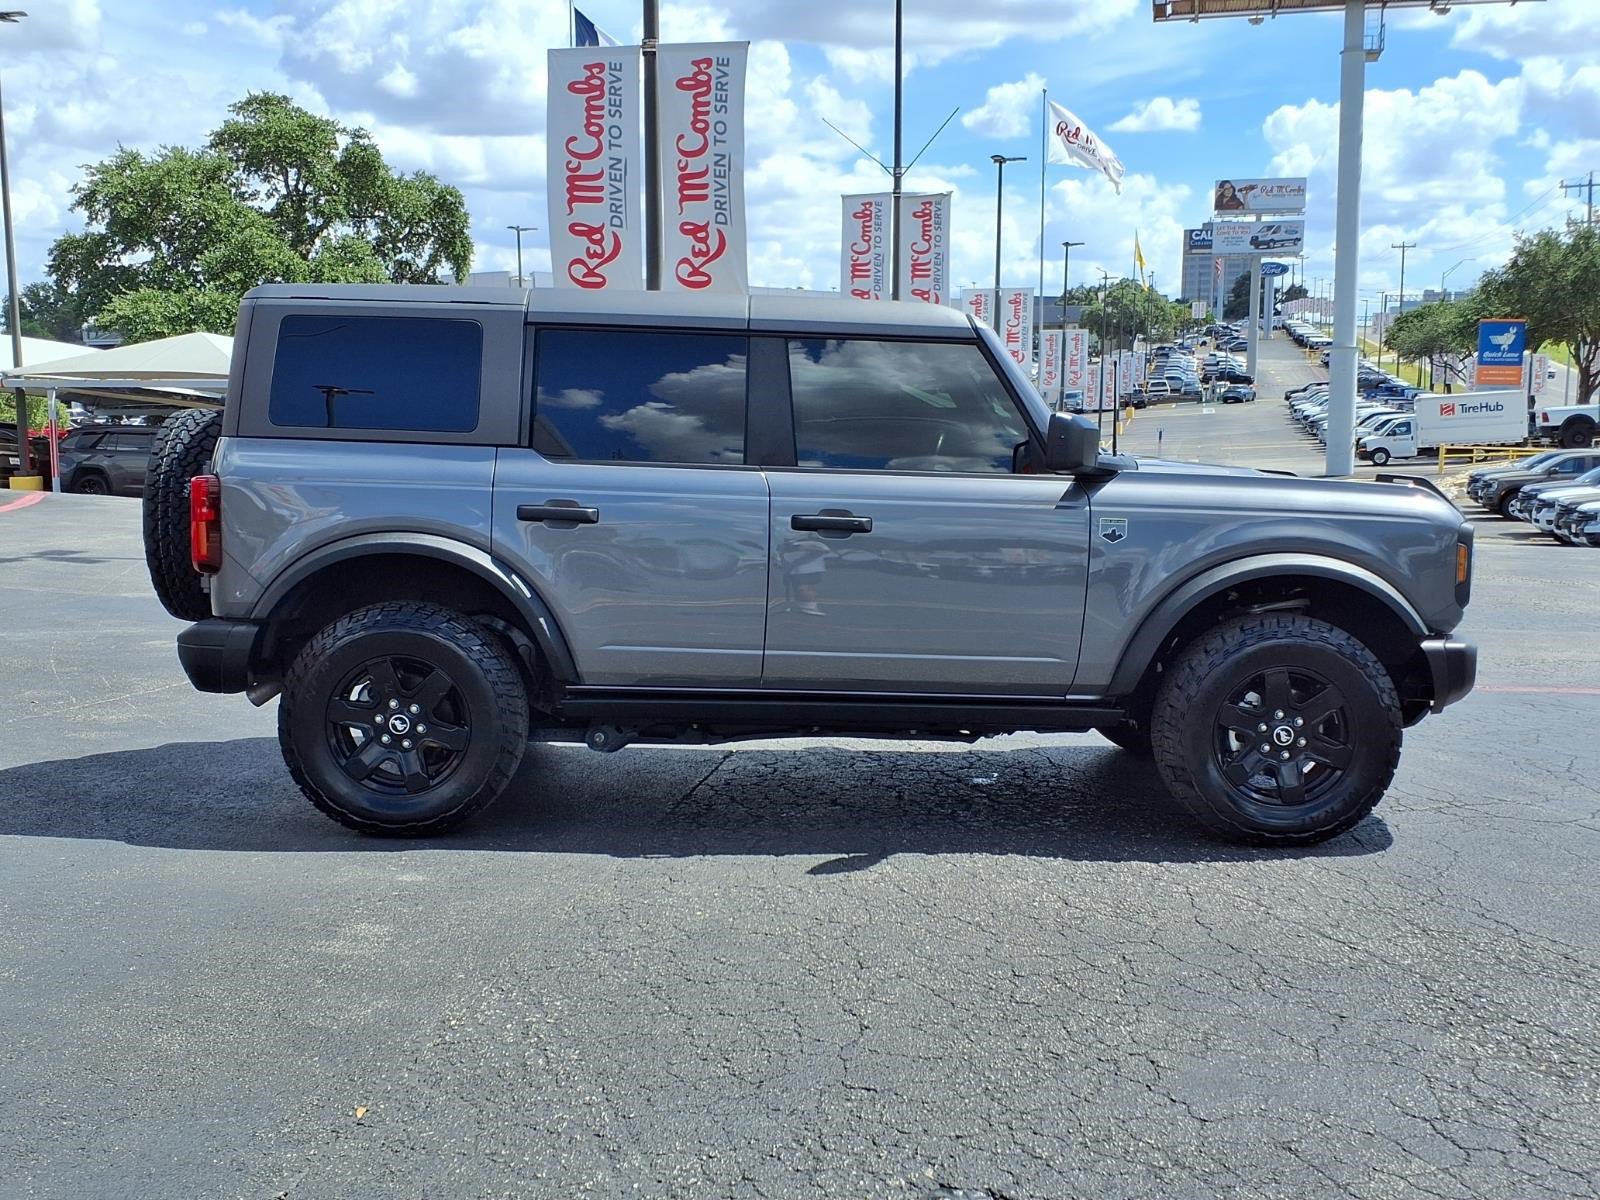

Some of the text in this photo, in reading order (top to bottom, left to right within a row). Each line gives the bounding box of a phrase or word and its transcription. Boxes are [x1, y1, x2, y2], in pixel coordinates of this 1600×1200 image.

[608, 61, 624, 229] DRIVEN TO SERVE
[714, 56, 731, 226] DRIVEN TO SERVE
[1056, 120, 1080, 144] Red
[568, 221, 621, 289] Red
[675, 219, 727, 289] Red
[873, 201, 883, 292] DRIVEN TO SERVE
[933, 200, 943, 292] DRIVEN TO SERVE
[1260, 264, 1282, 274] Ford
[1458, 400, 1504, 414] TireHub
